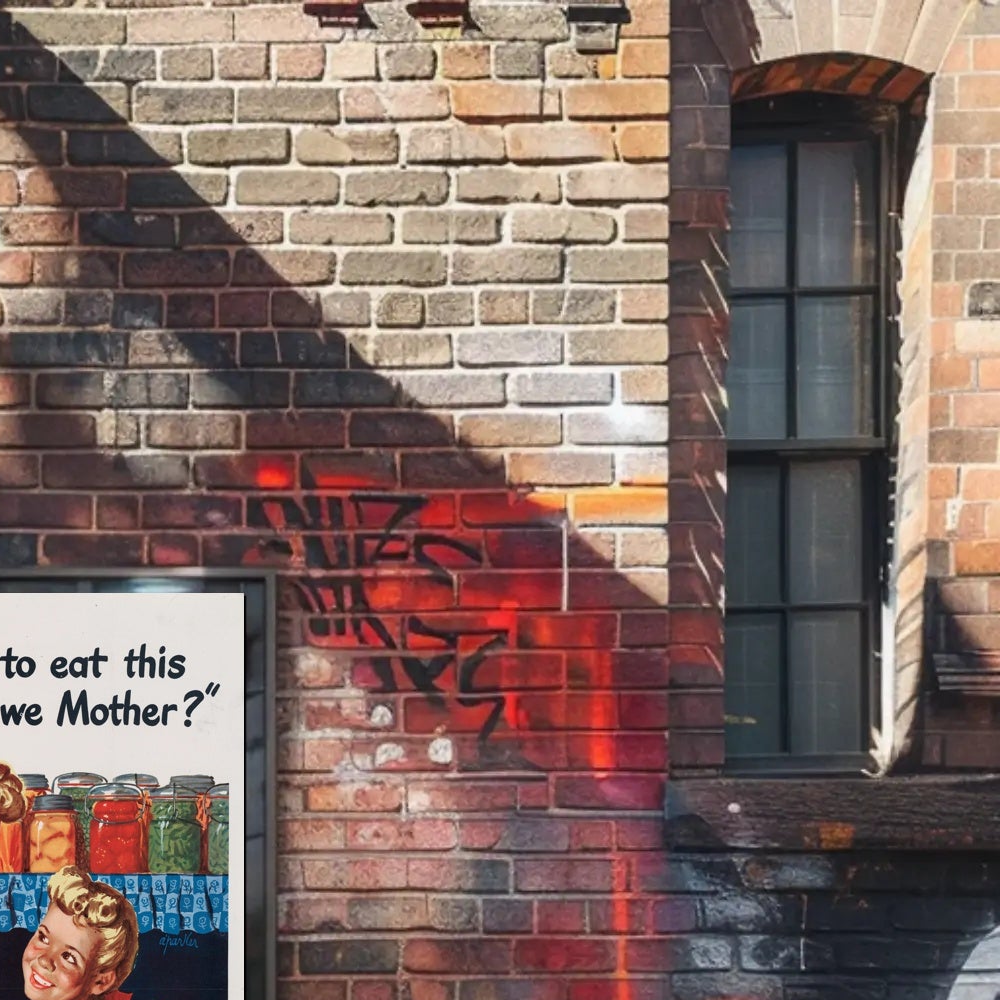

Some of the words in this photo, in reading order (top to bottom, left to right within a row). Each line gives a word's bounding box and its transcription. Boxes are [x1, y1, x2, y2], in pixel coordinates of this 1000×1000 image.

[49, 647, 109, 679] eat
[123, 643, 187, 680] this
[0, 703, 44, 727] we
